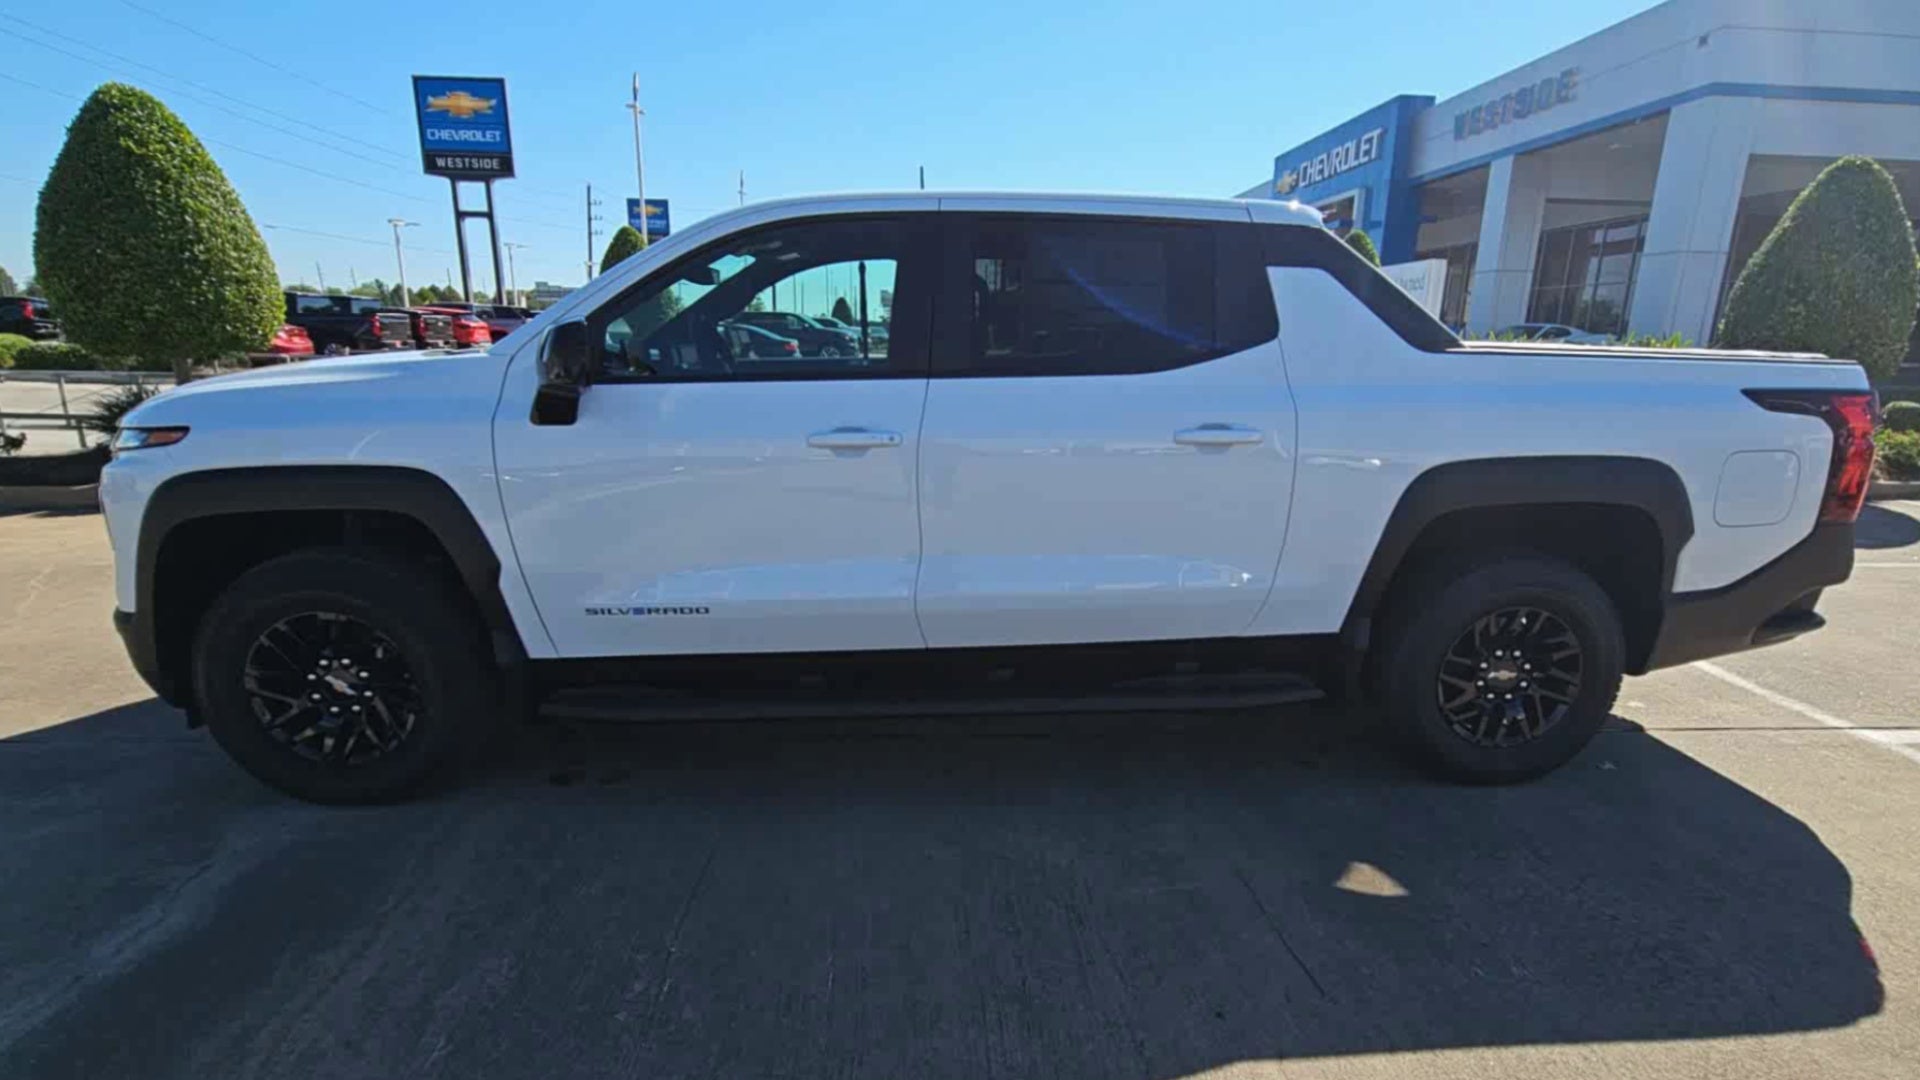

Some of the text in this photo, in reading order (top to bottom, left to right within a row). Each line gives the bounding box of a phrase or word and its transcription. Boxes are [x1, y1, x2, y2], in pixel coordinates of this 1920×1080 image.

[1454, 66, 1580, 140] WESTSIDE
[426, 128, 501, 142] CHEVROLET
[435, 156, 501, 169] WESTSIDE
[1299, 127, 1383, 187] CHEVROLET
[584, 606, 710, 616] SILVERADO
